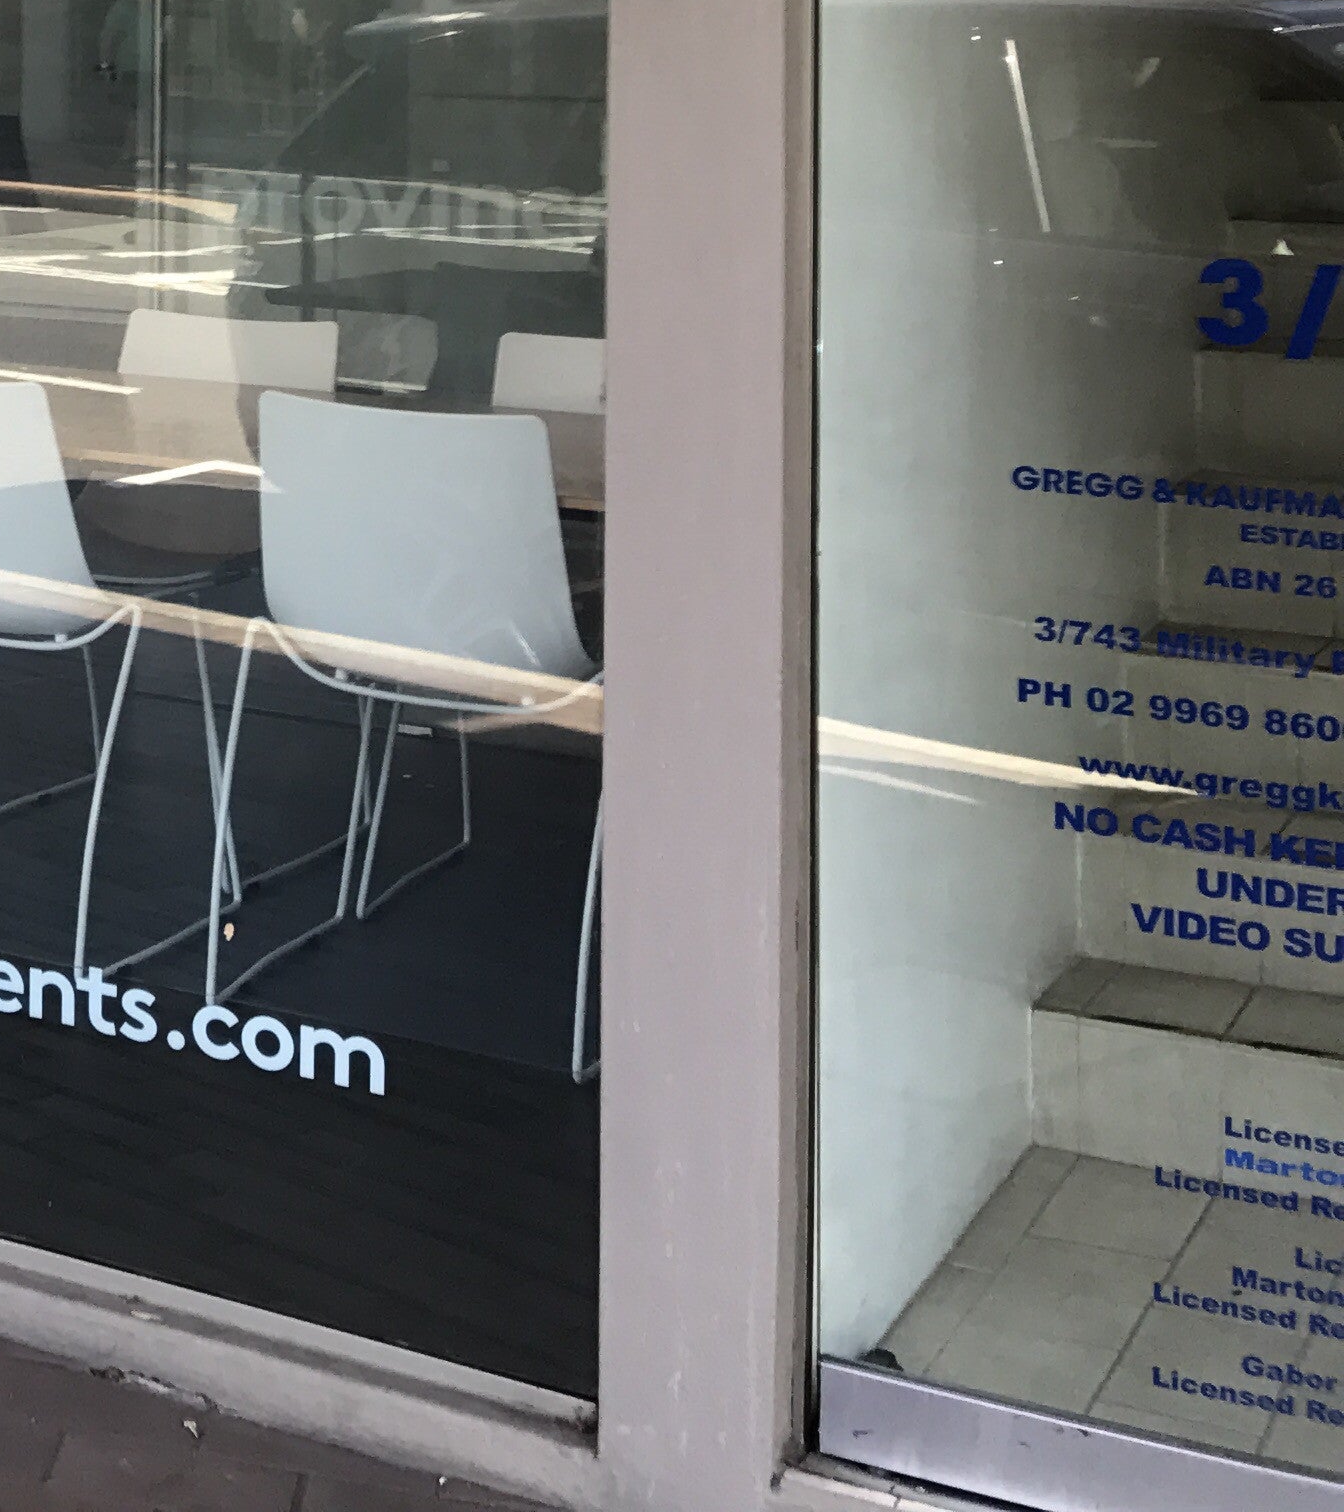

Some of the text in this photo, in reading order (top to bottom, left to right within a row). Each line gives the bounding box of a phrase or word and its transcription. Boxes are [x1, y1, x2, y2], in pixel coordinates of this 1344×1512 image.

[1012, 465, 1344, 519] GREGG & KAUFMA
[1240, 524, 1344, 551] ESTAB
[1204, 564, 1338, 599] ABN 26
[1034, 616, 1142, 653] 3/743
[1157, 630, 1316, 679] Military
[1018, 677, 1344, 742] PH 02 9969 860
[1054, 801, 1119, 837] NO
[1132, 813, 1256, 858] CASH
[1196, 868, 1344, 916] UNDER
[1130, 902, 1271, 951] VIDEO
[1154, 1164, 1299, 1212] Licensed
[1224, 1147, 1344, 1188] Marto
[1153, 1281, 1297, 1330] Licensed
[1151, 1365, 1296, 1416] Licensed
[1240, 1354, 1338, 1391] Gabor
